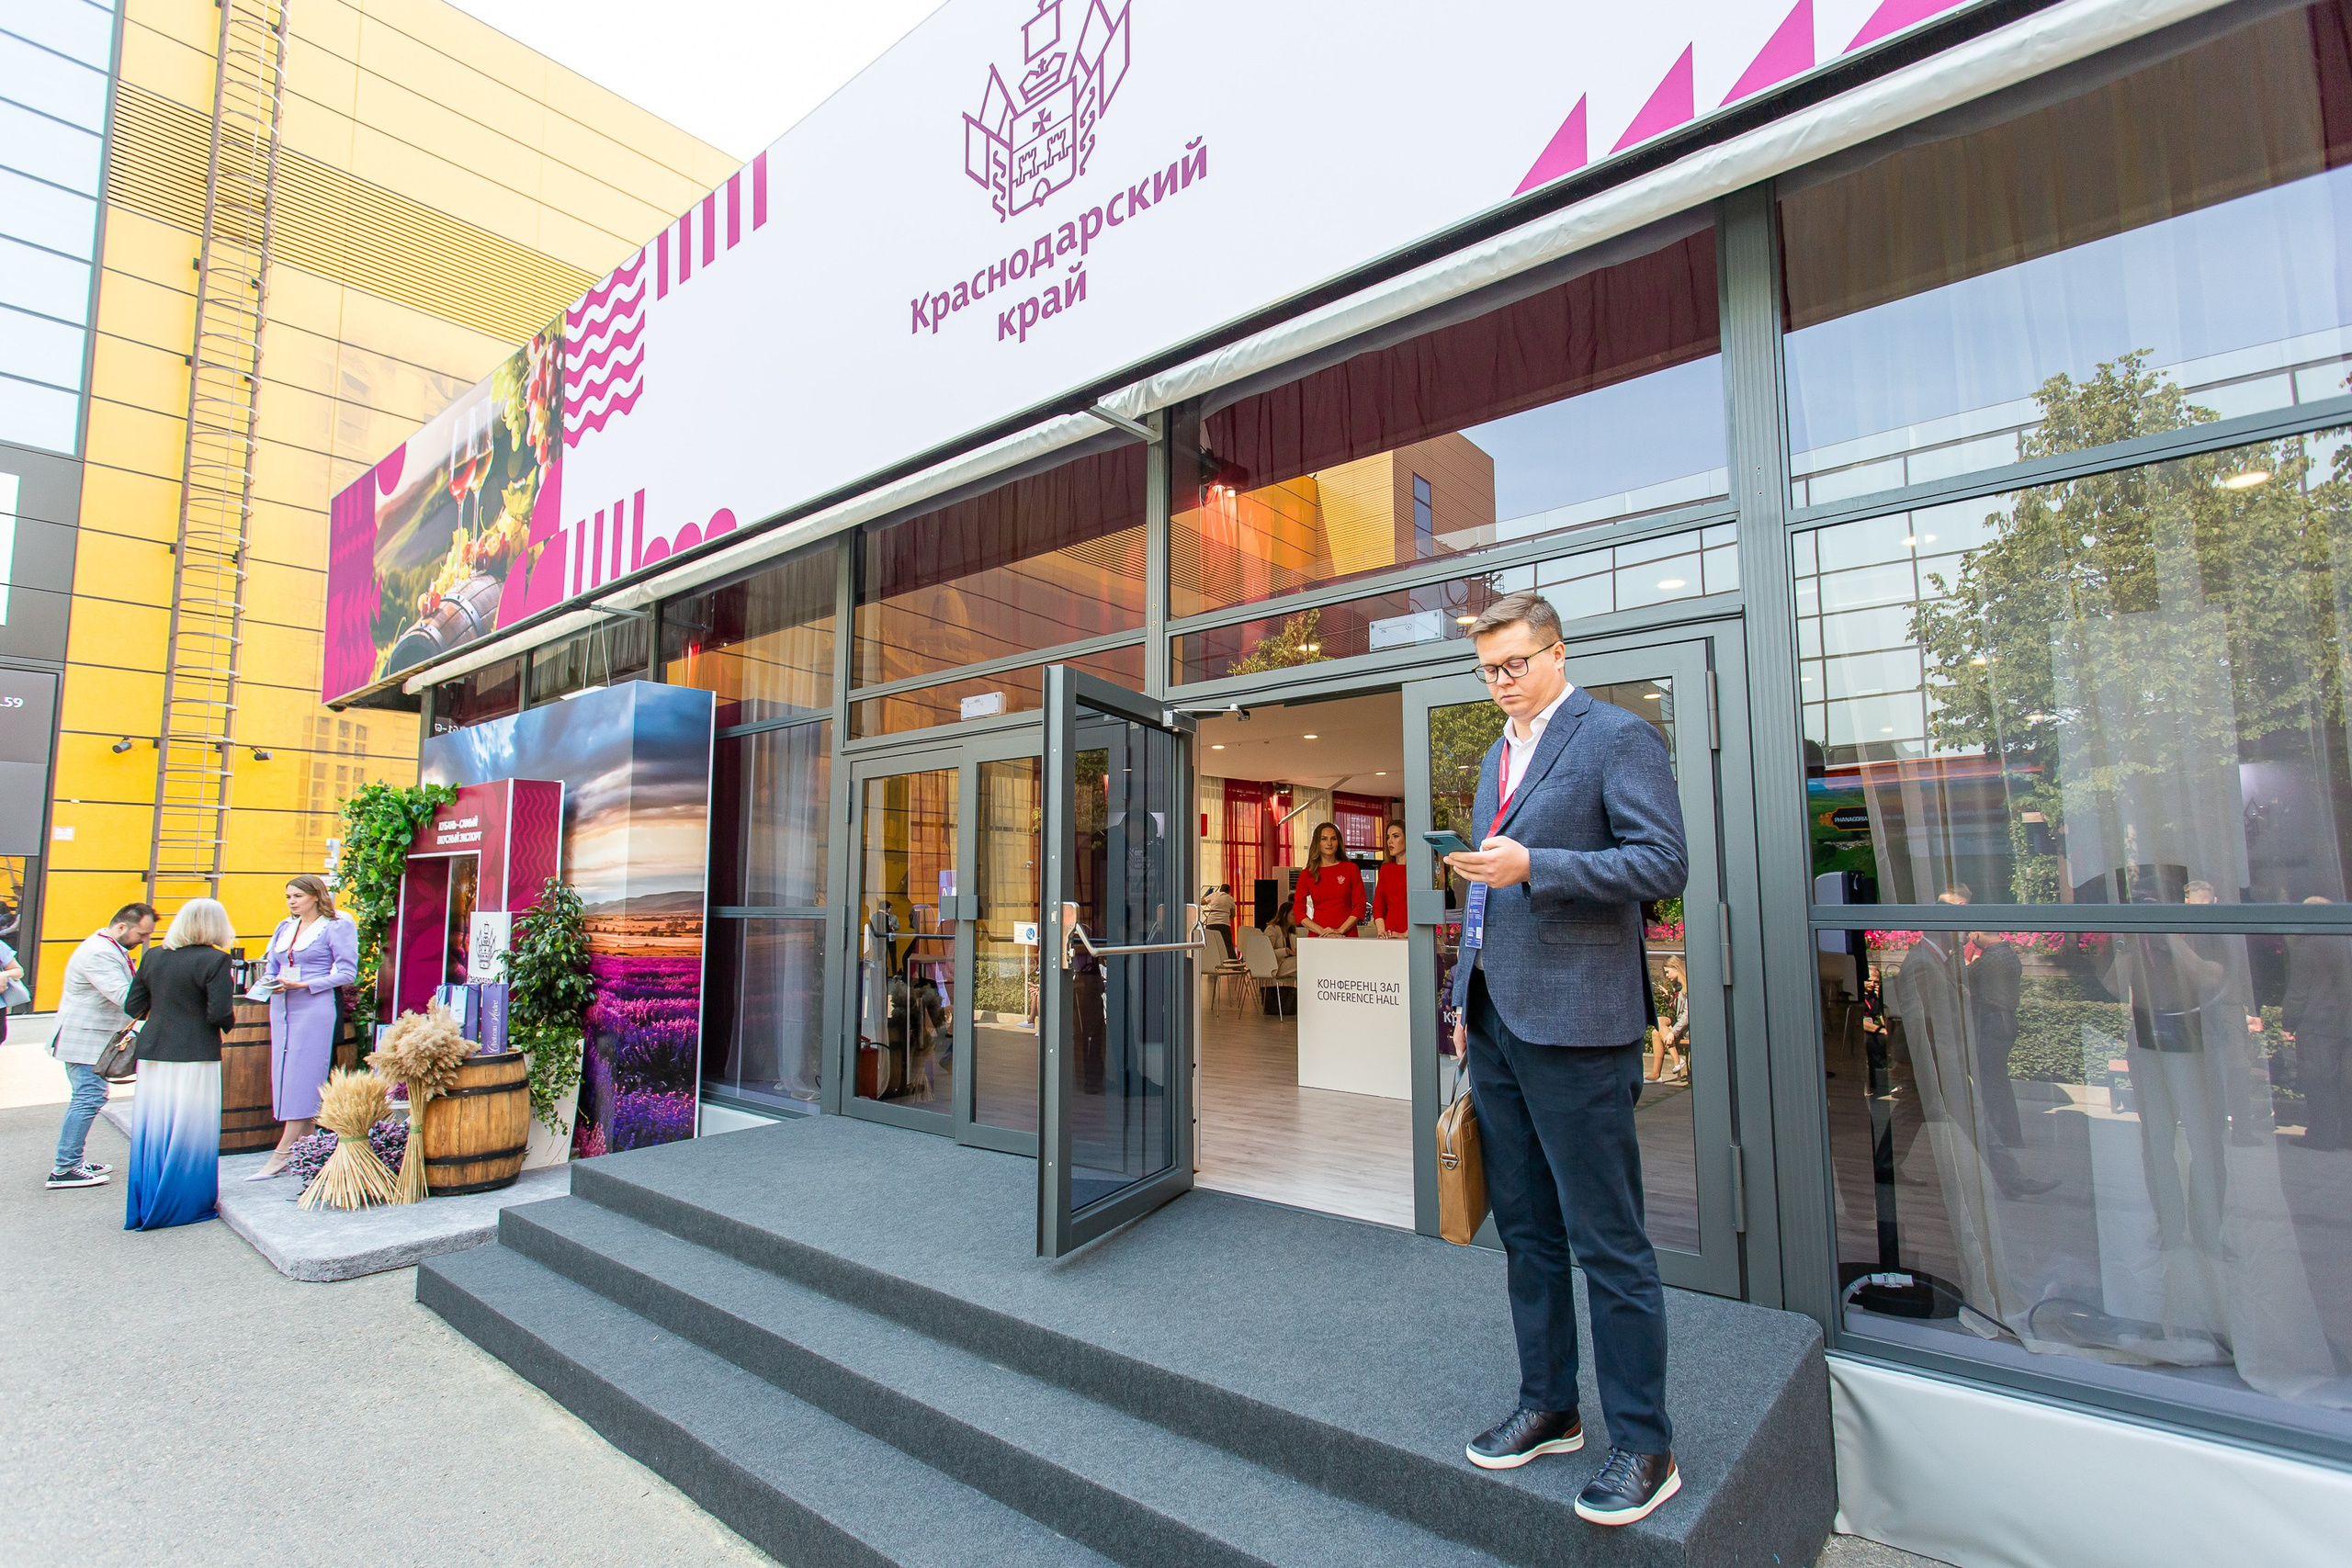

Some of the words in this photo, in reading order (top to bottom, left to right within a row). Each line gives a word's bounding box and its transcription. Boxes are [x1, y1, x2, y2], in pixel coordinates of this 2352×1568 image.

[910, 135, 1207, 334] Краснодарский
[998, 261, 1087, 343] край
[1317, 978, 1377, 994] КОНФЕРЕНЦ
[1380, 982, 1400, 993] ЗАЛ
[1317, 990, 1374, 1004] CONFERENCE
[1376, 995, 1399, 1006] HALL
